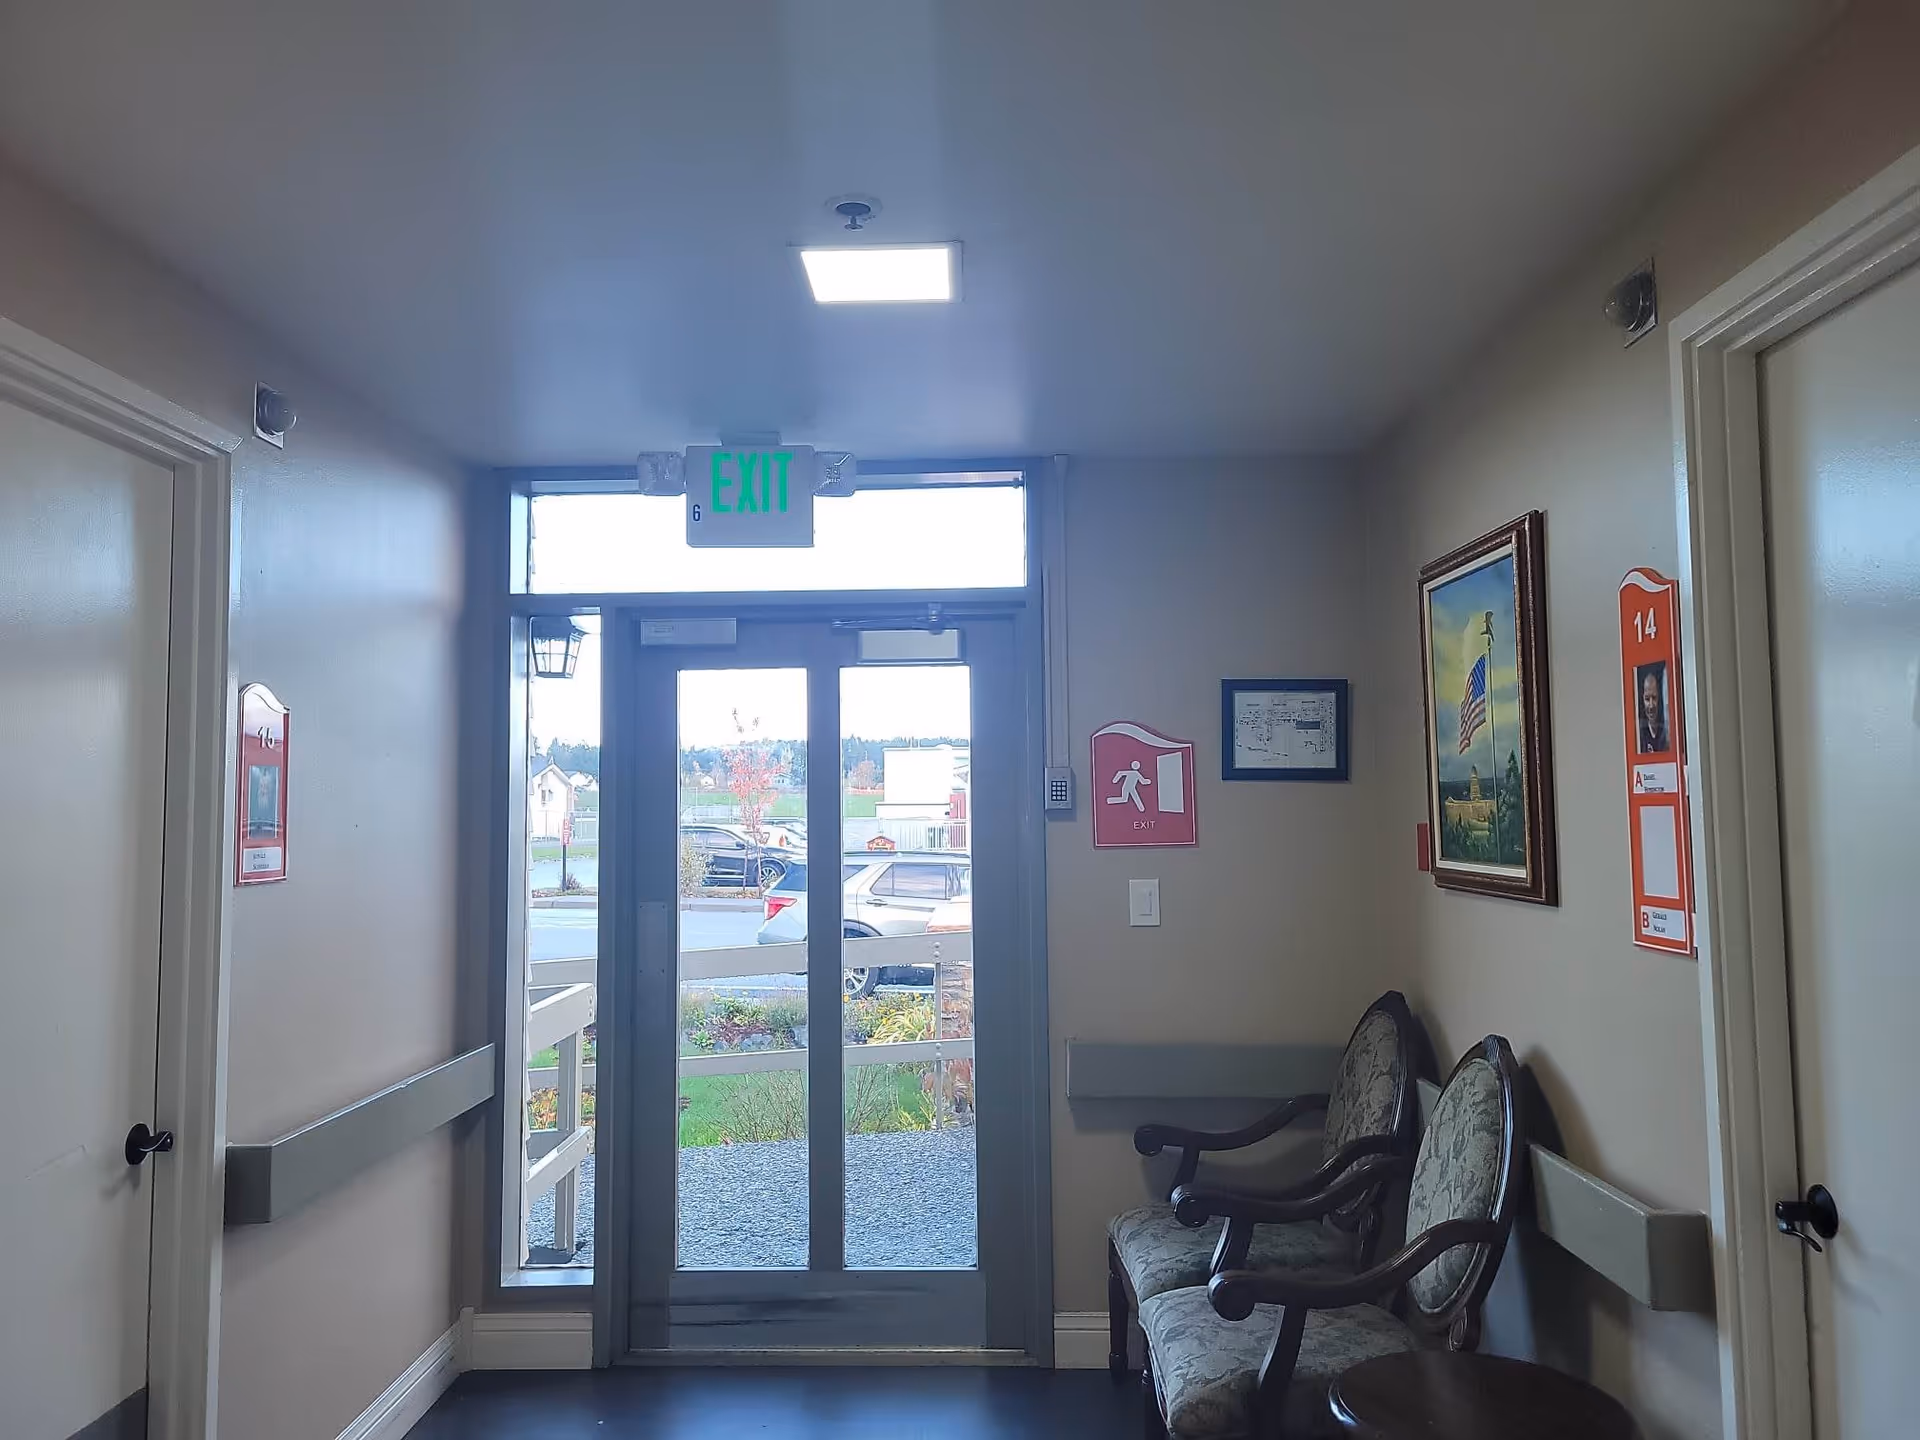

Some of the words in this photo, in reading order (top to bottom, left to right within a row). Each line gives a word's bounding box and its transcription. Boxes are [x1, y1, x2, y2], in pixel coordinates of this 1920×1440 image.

[711, 452, 794, 514] EXIT
[692, 504, 701, 522] 6
[1634, 607, 1658, 643] 14
[1635, 771, 1643, 788] A
[1133, 820, 1156, 830] EXIT
[1642, 911, 1650, 928] B
